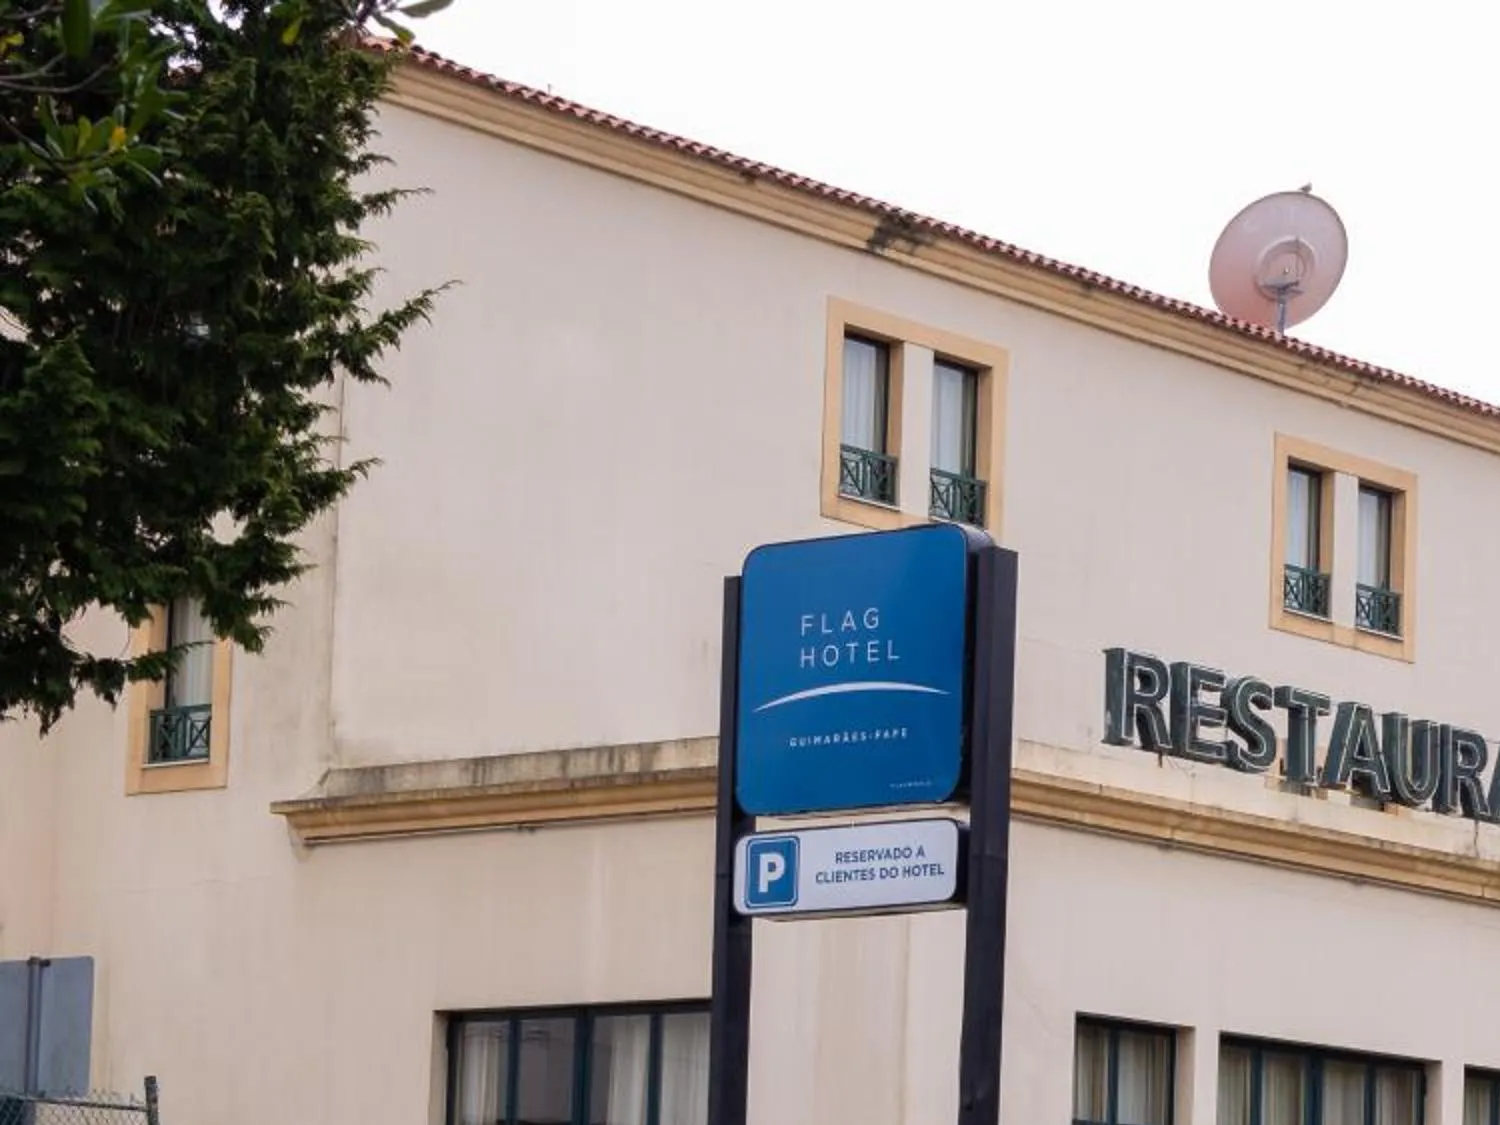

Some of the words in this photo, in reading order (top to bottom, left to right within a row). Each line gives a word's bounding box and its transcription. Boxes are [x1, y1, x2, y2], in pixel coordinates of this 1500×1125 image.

[801, 607, 879, 636] FLAG
[800, 640, 900, 668] HOTEL
[835, 846, 913, 864] RESERVADO
[917, 845, 925, 858] A
[758, 852, 785, 893] P
[815, 869, 876, 884] CLIENTES
[879, 866, 899, 880] DO
[902, 863, 945, 877] HOTEL
